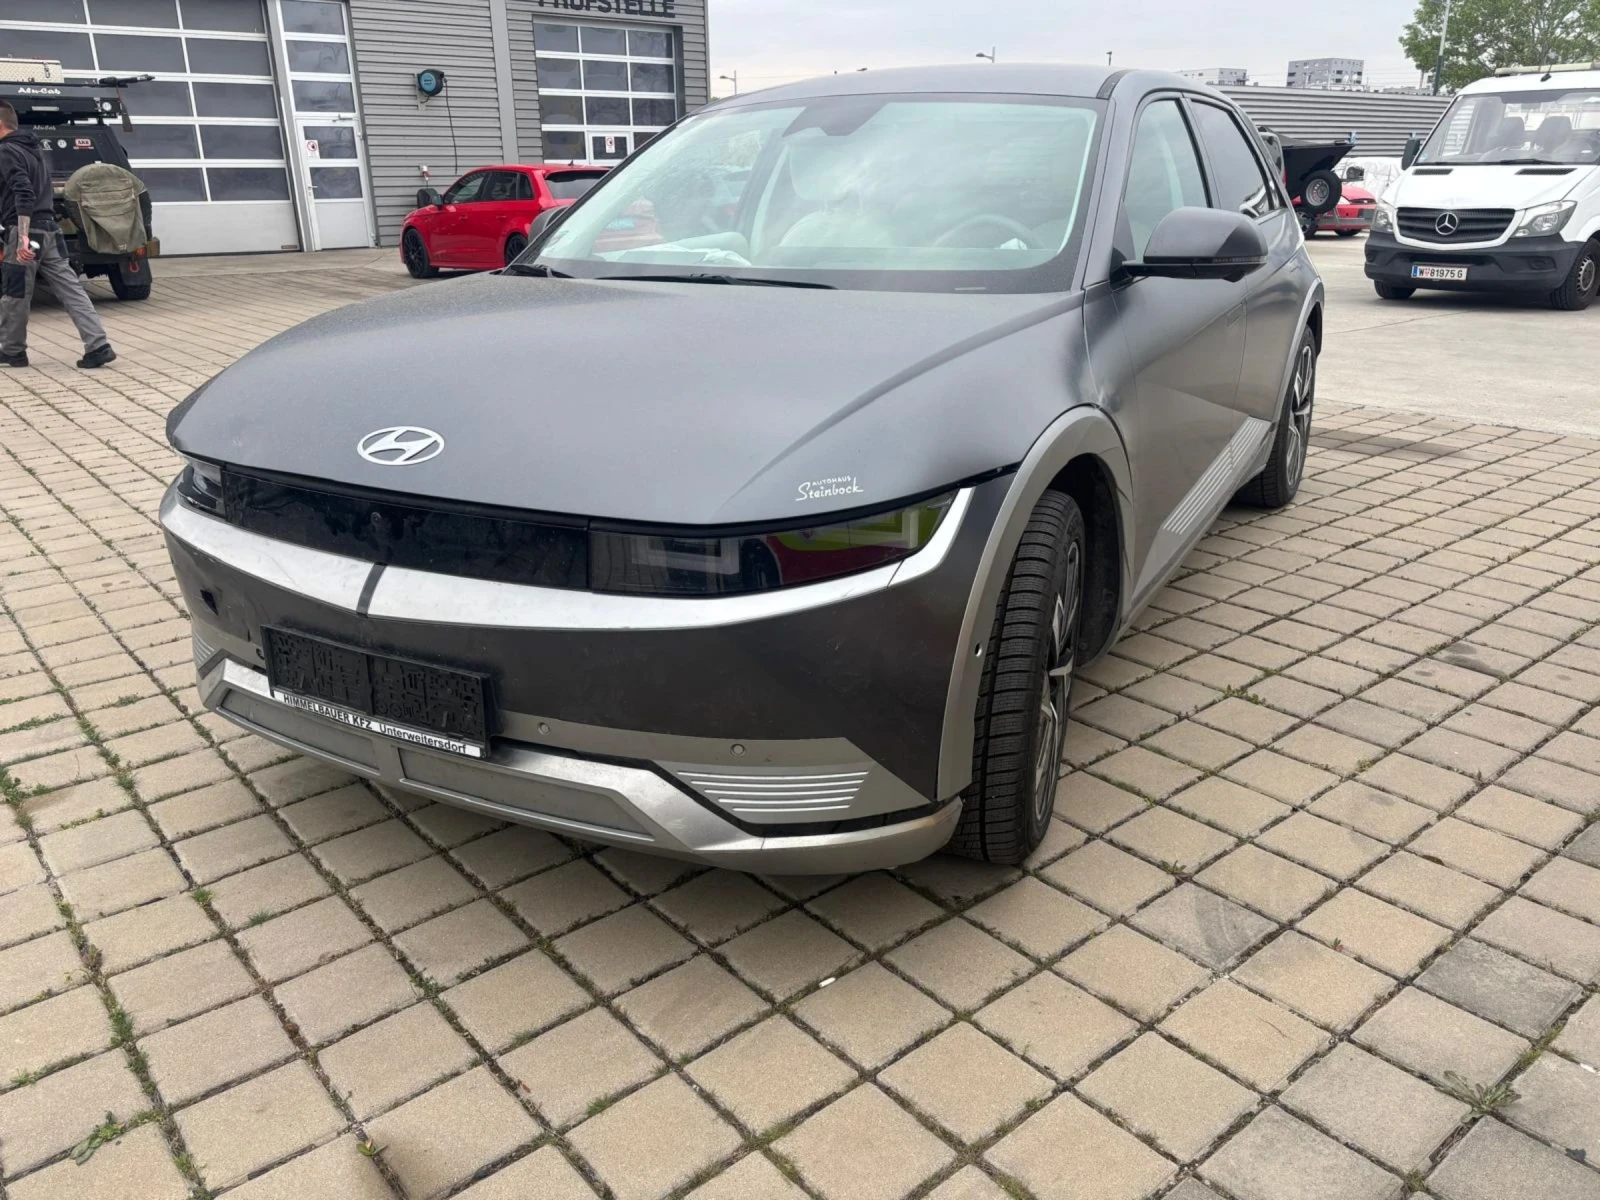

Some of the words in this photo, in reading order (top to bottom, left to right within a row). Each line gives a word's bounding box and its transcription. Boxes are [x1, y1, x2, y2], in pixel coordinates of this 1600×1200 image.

[796, 477, 864, 501] Steinbock
[812, 475, 851, 486] AUTOHAUS
[283, 694, 350, 723] HIMMELBAUER
[352, 714, 372, 730] KFZ
[379, 723, 466, 754] Unterweitersdorf
